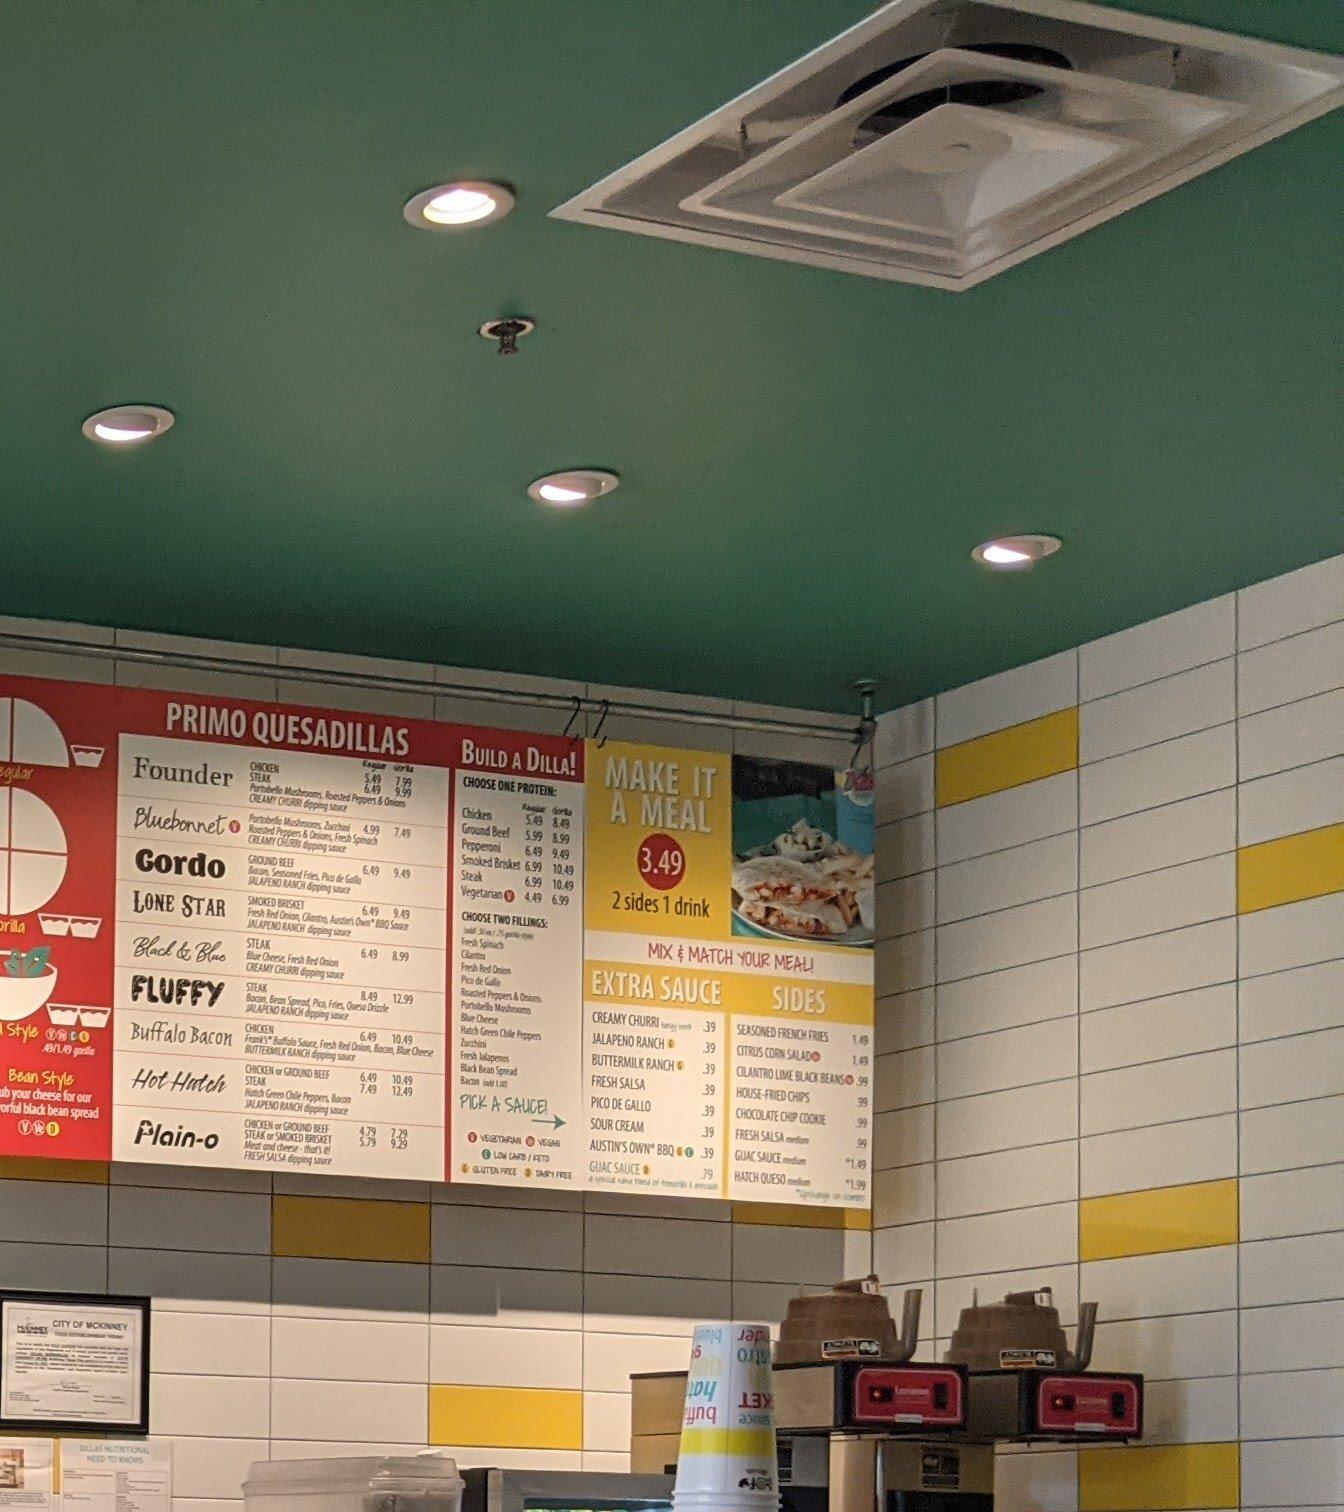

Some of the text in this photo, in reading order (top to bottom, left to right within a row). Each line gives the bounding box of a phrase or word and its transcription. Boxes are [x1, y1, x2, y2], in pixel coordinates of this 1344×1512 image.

[167, 702, 409, 756] PRIMO QUESADILLAS
[132, 756, 233, 787] Founder
[605, 757, 716, 798] MAKE IT
[462, 776, 557, 797] CHOOSE ONE PROTEIN:
[134, 807, 227, 836] Bluebonnet
[611, 794, 712, 833] A MEAL
[135, 849, 226, 878] Gordo
[641, 847, 682, 874] 3.49
[132, 890, 226, 917] LONE STAR
[612, 891, 709, 918] 2 sides 1 drink
[132, 936, 226, 963] Black & Blue
[648, 943, 672, 959] MIX
[688, 946, 733, 965] MATCH
[738, 949, 770, 968] YOUR
[775, 953, 813, 974] MEAL!
[131, 974, 225, 1007] FLUFFY
[592, 969, 722, 1006] EXTRA SAUCE
[772, 985, 826, 1014] SIDES
[8, 1021, 38, 1039] Style
[592, 1011, 659, 1028] CREAMY CHURRI
[131, 1021, 232, 1046] Buffalo Bacon
[592, 1033, 665, 1049] JALAPENO RANCH
[8, 1068, 74, 1086] Bean Style
[132, 1068, 227, 1093] Hot Hatch
[460, 1094, 548, 1114] PICK A SAUCE!
[134, 1120, 218, 1149] Plain-o
[590, 1117, 644, 1132] SOUR CREAM
[53, 1320, 71, 1328] CITY
[86, 1322, 127, 1330] MCKINNEY
